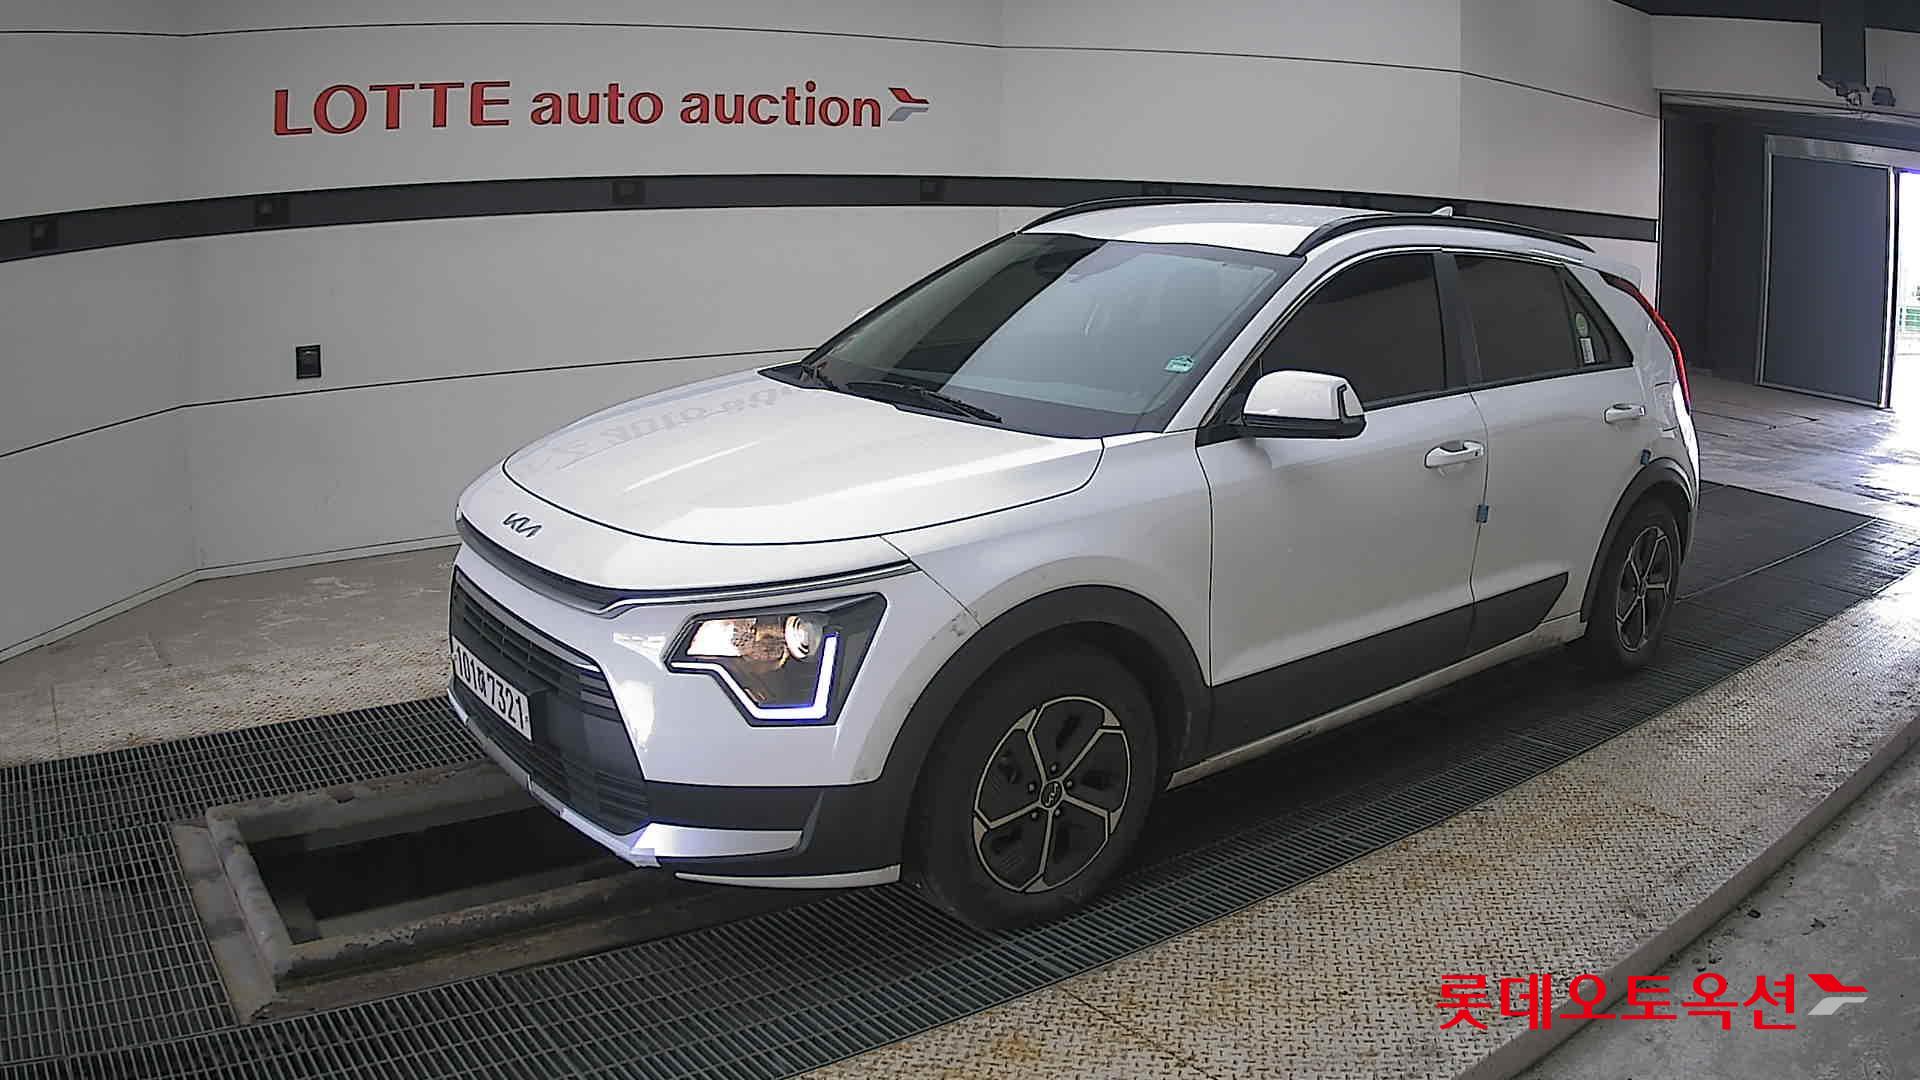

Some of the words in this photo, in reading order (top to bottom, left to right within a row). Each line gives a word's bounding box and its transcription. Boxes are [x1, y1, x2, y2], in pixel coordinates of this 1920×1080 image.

[273, 80, 511, 137] LOTTE
[529, 82, 665, 127] auto
[678, 81, 883, 128] auction
